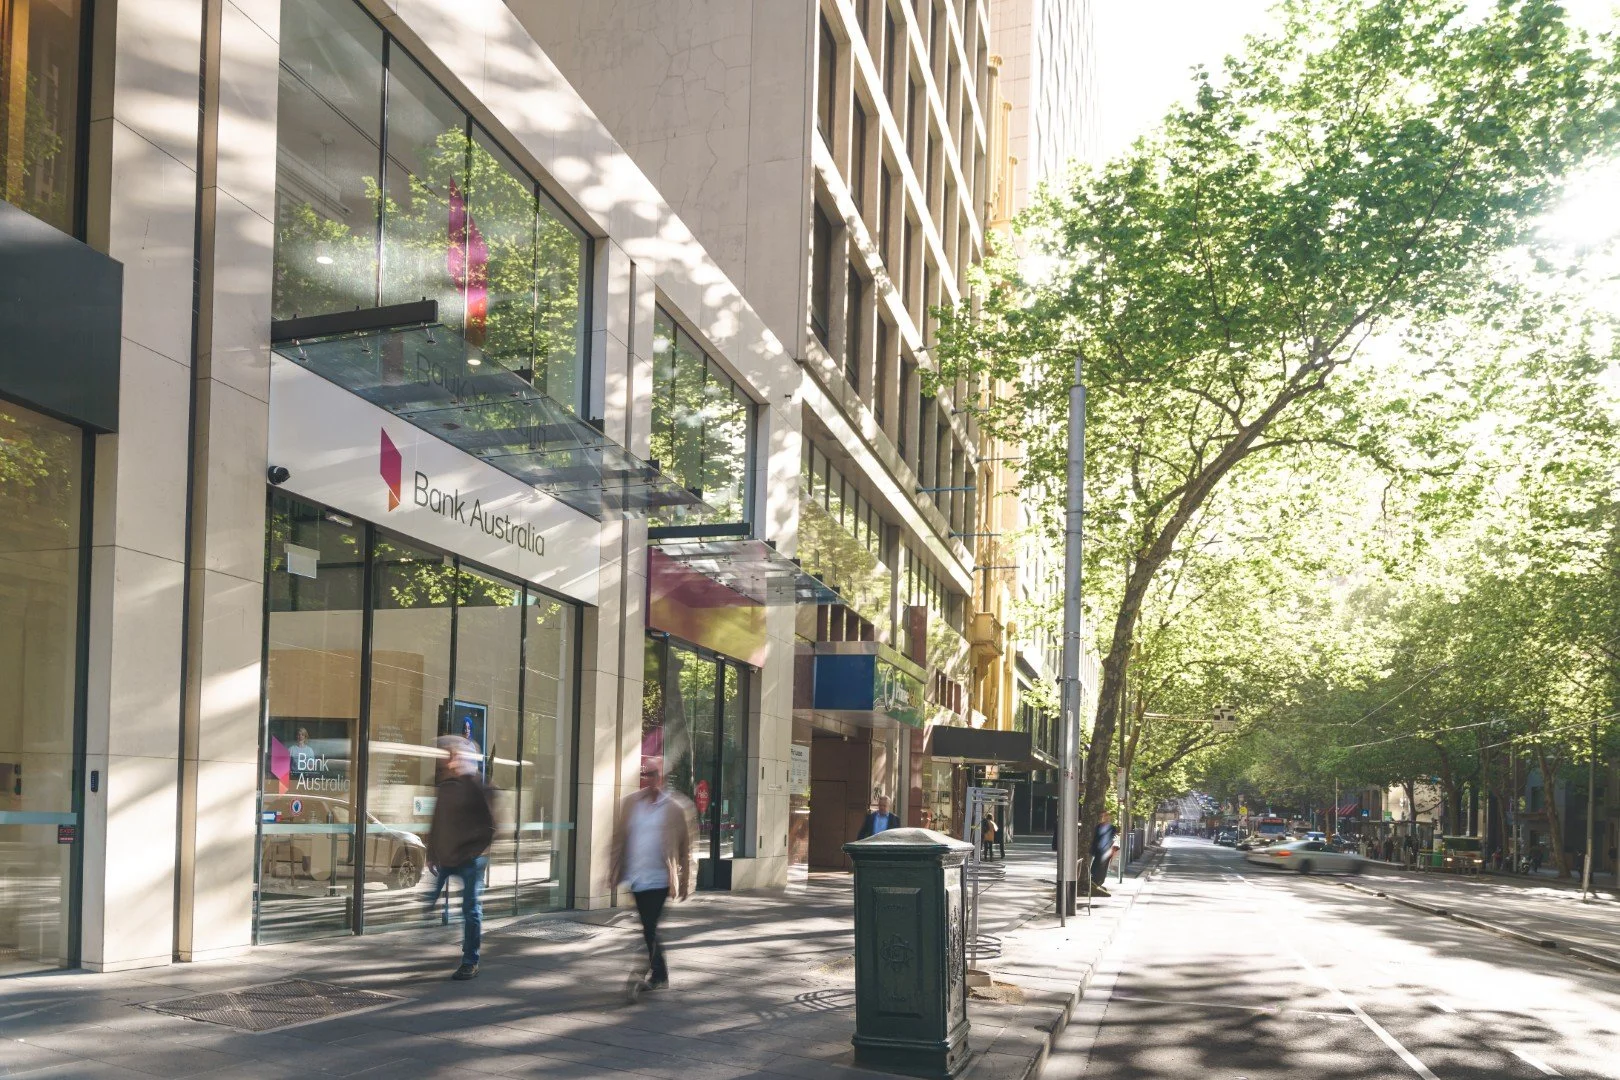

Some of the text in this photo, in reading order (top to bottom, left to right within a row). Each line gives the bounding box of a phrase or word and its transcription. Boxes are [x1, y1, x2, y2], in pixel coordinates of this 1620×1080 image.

[414, 470, 545, 557] Bank Australia
[297, 752, 329, 772] Bank
[296, 772, 350, 792] Australia
